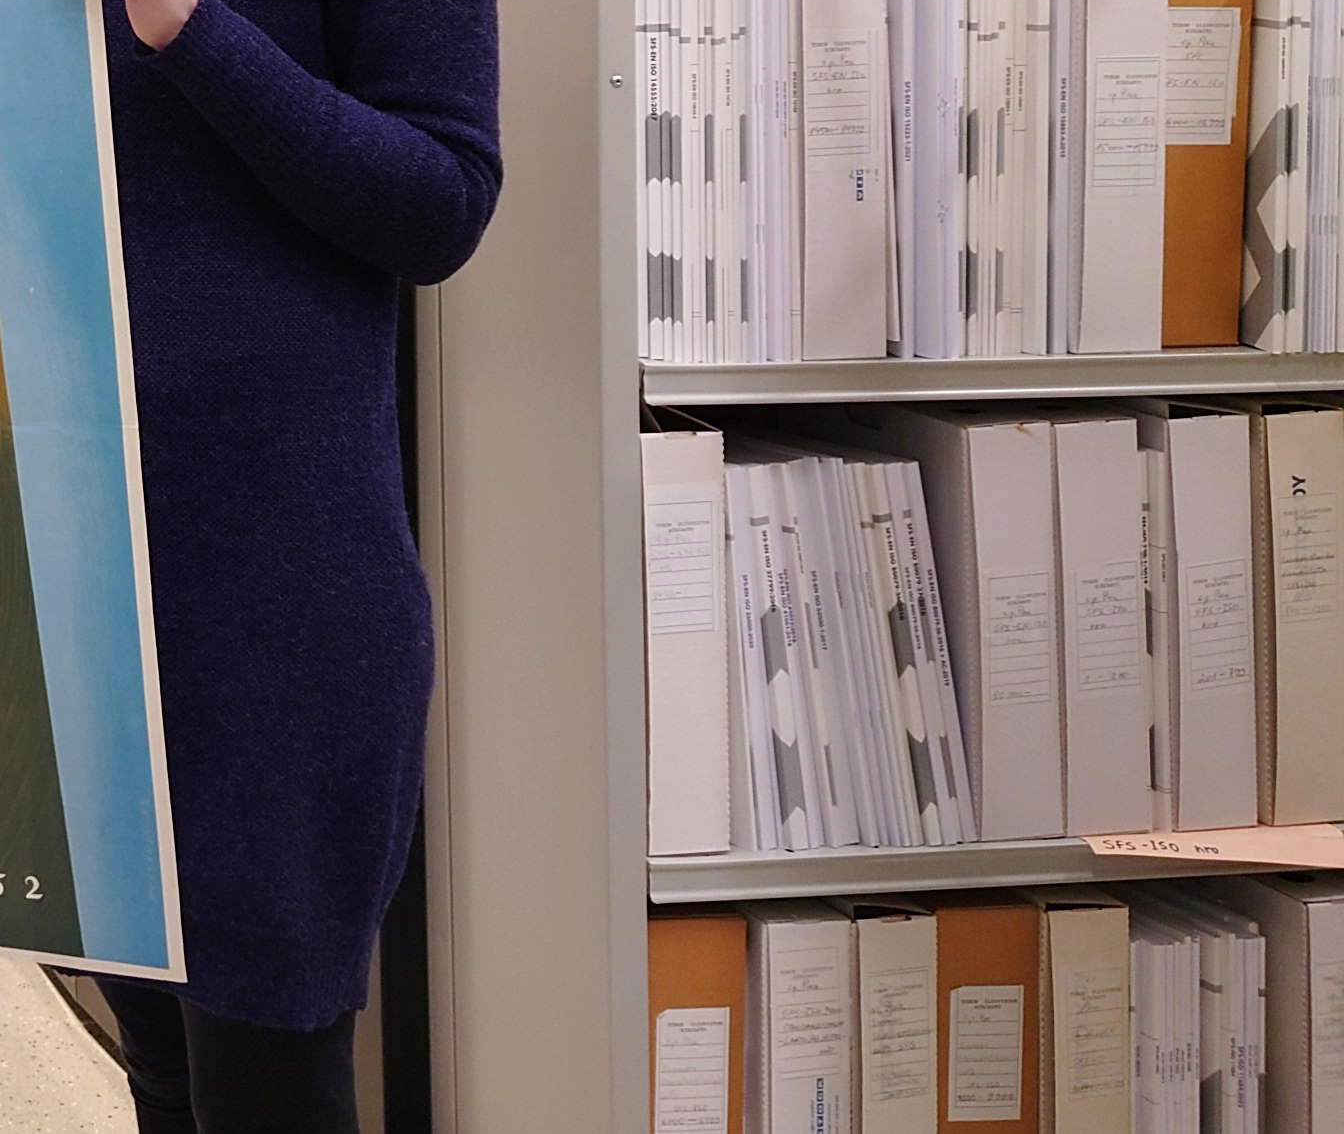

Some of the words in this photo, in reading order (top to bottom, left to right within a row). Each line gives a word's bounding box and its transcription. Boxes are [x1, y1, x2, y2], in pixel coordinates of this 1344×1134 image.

[650, 78, 658, 122] 14555:2017
[761, 529, 770, 554] SFS-EN
[885, 526, 894, 551] SFS-EN
[906, 522, 916, 547] SFS-EN
[764, 555, 772, 568] ISO
[888, 552, 896, 565] ISO
[910, 548, 918, 561] ISO
[742, 574, 750, 598] SFS-EN
[811, 570, 819, 594] SFS-EN
[926, 568, 936, 592] SFS-EN
[744, 598, 752, 611] ISO
[814, 594, 822, 607] ISO
[930, 593, 938, 605] ISO
